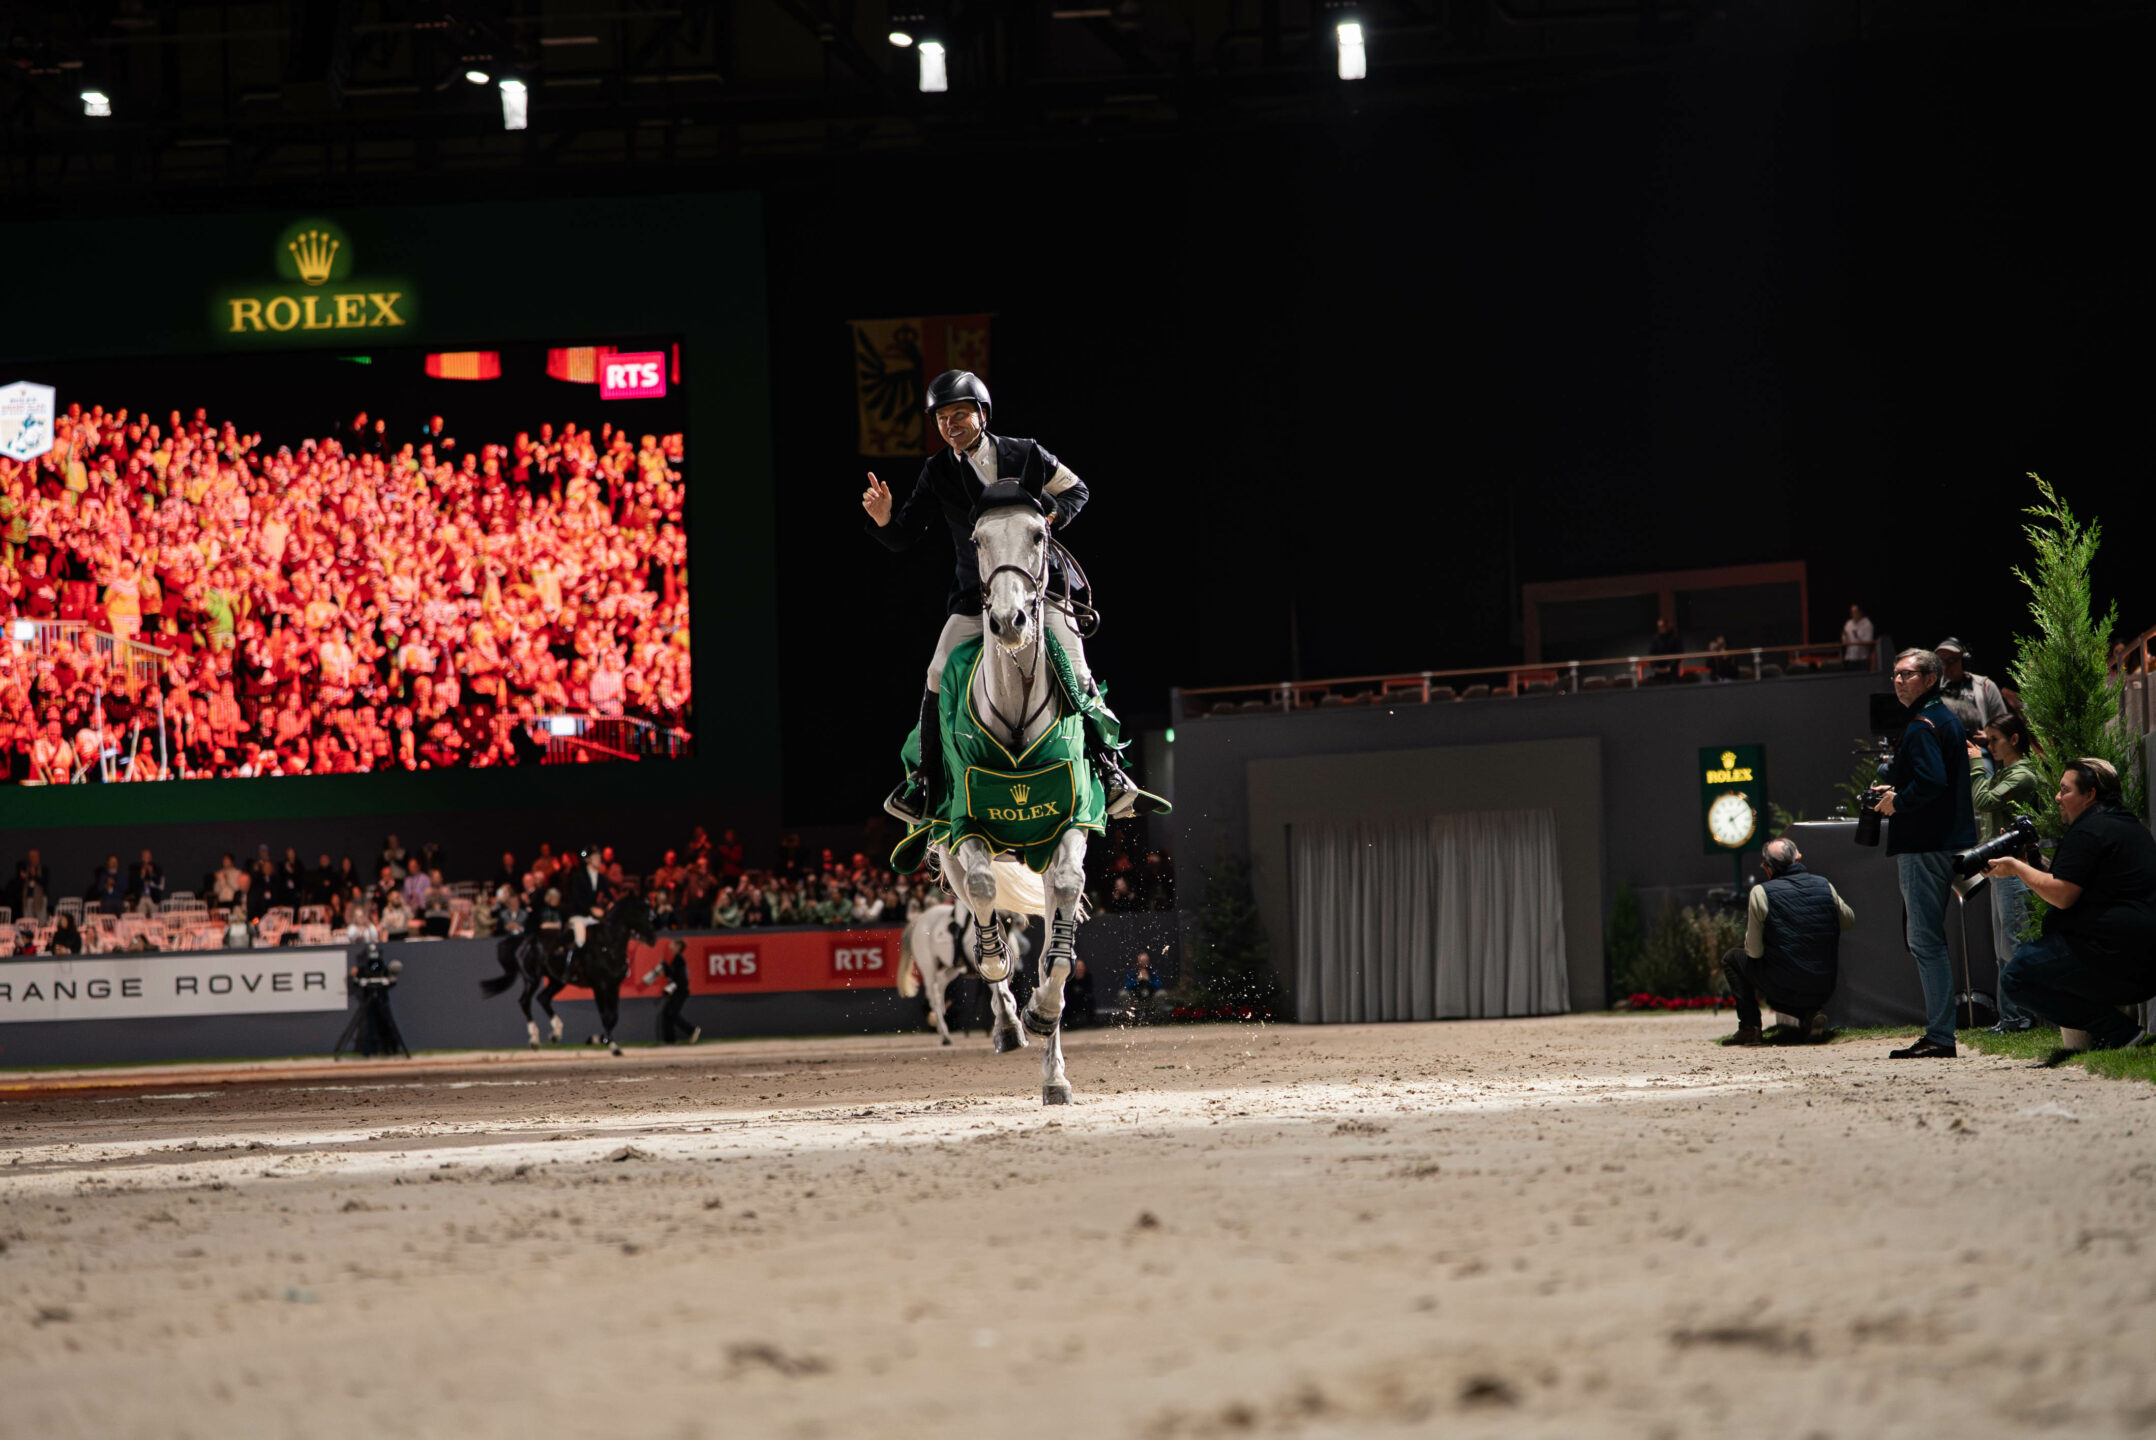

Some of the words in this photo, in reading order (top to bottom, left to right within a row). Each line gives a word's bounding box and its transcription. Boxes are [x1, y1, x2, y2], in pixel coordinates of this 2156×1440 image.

[228, 292, 406, 332] ROLEX
[606, 362, 660, 389] RTS
[1706, 767, 1754, 784] ROLEX
[987, 801, 1060, 821] ROLEX
[708, 952, 757, 976] RTS
[834, 948, 884, 971] RTS
[175, 971, 327, 995] ROVER
